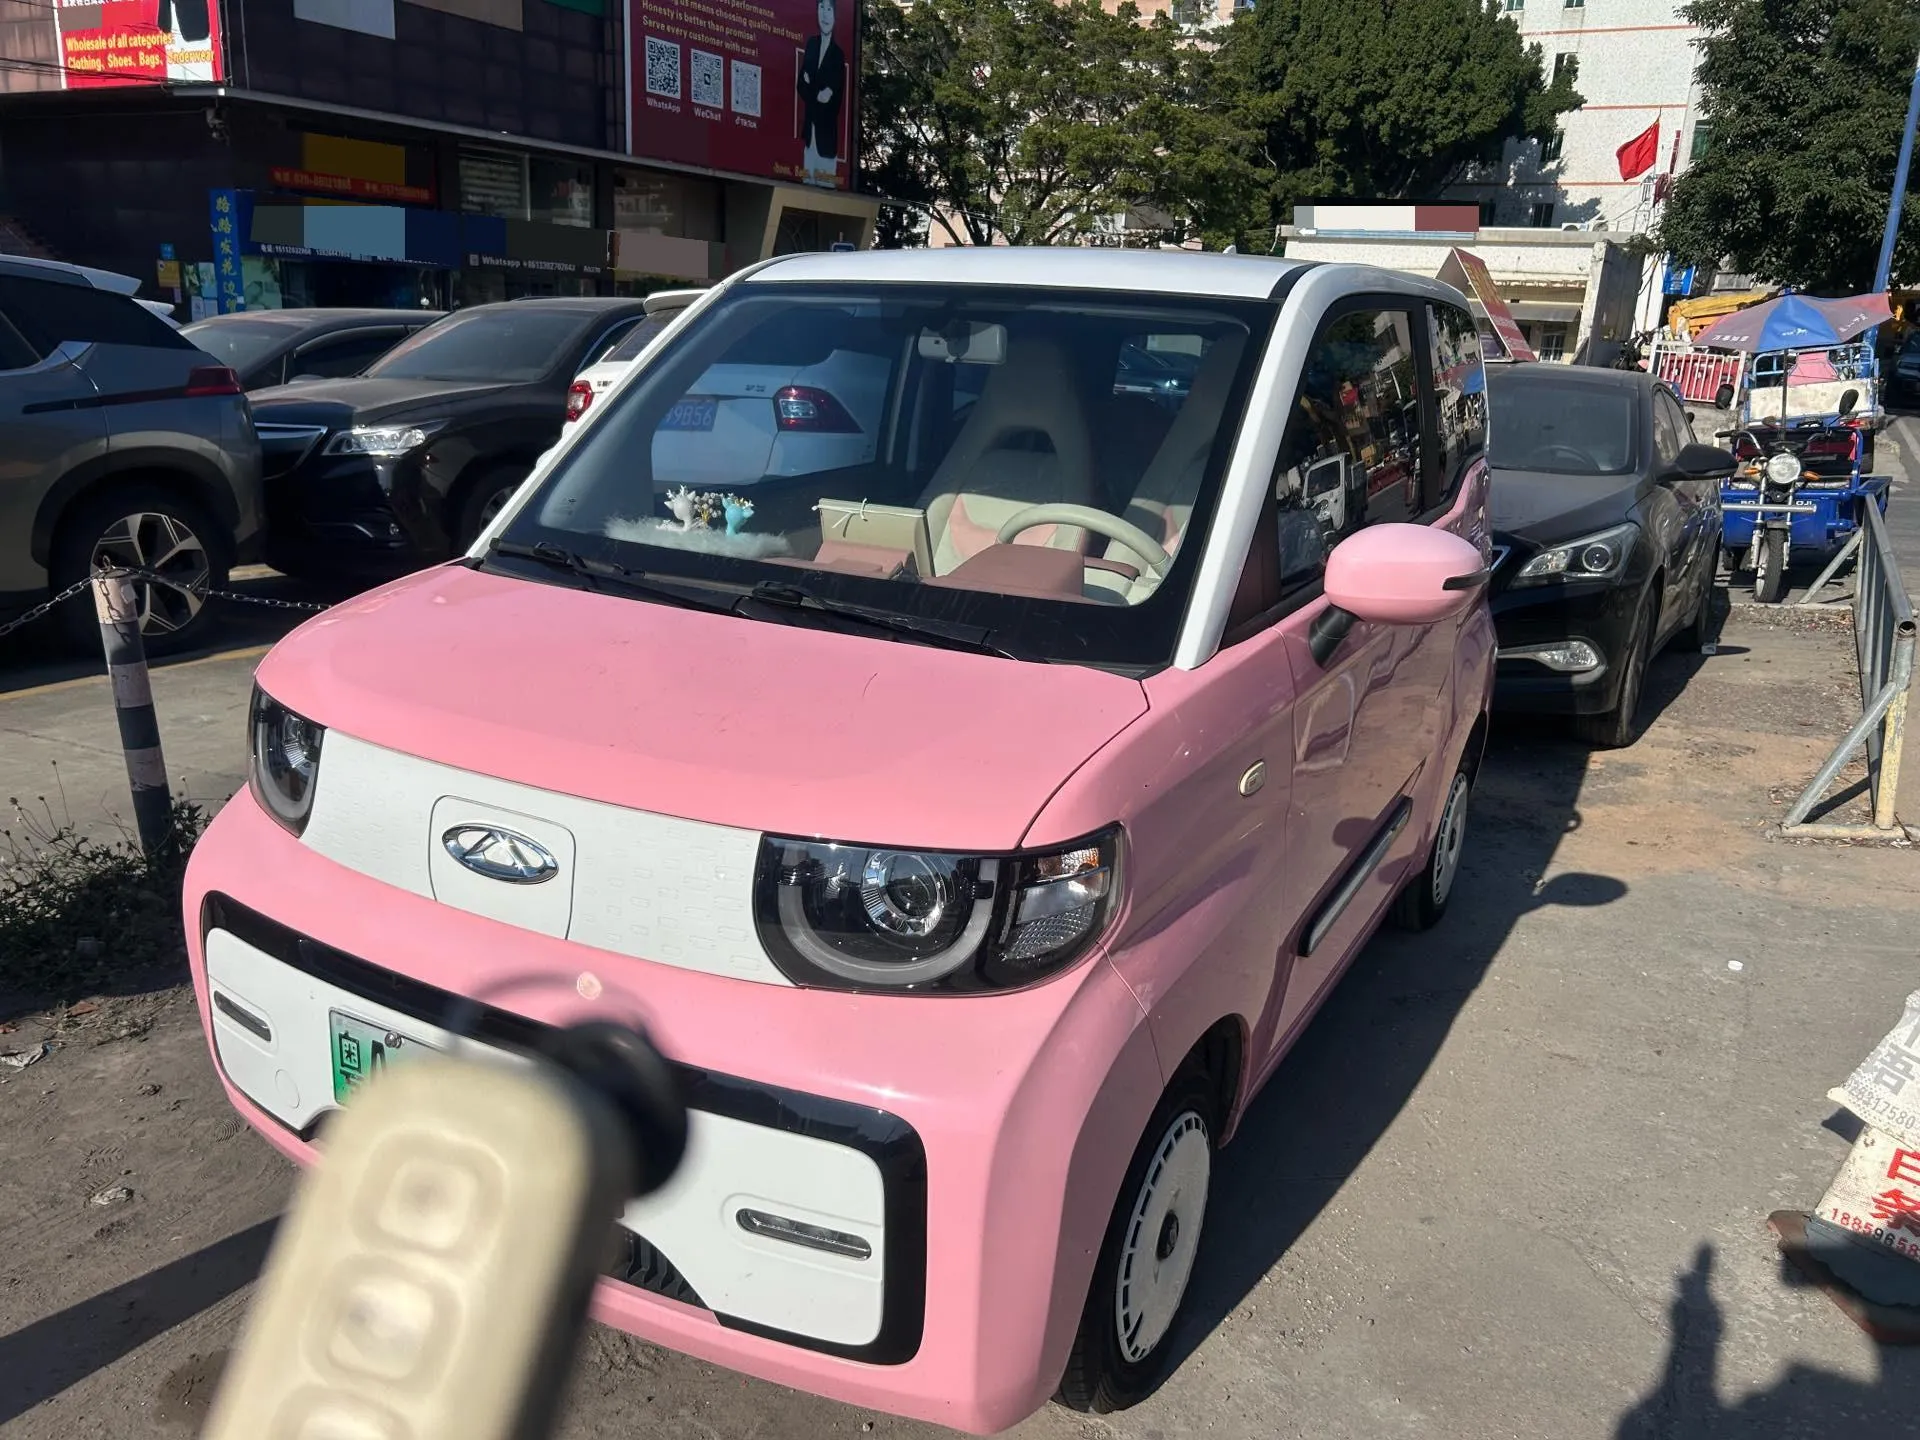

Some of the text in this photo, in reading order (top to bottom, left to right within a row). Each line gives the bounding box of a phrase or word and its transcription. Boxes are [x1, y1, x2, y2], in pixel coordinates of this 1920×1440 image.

[642, 0, 674, 20] Honesty
[675, 10, 683, 20] is
[684, 12, 706, 28] better
[707, 20, 724, 32] than
[690, 1, 714, 16] means
[715, 8, 747, 27] choosing
[748, 19, 771, 32] quality
[772, 26, 785, 36] and
[66, 36, 107, 51] Wholesale
[108, 34, 117, 49] of
[117, 33, 127, 47] all
[642, 15, 665, 31] Serve
[666, 25, 688, 39] every
[688, 31, 723, 47] customer
[724, 40, 740, 51] with
[646, 97, 680, 113] WhatsApp
[694, 106, 721, 121] WeChat
